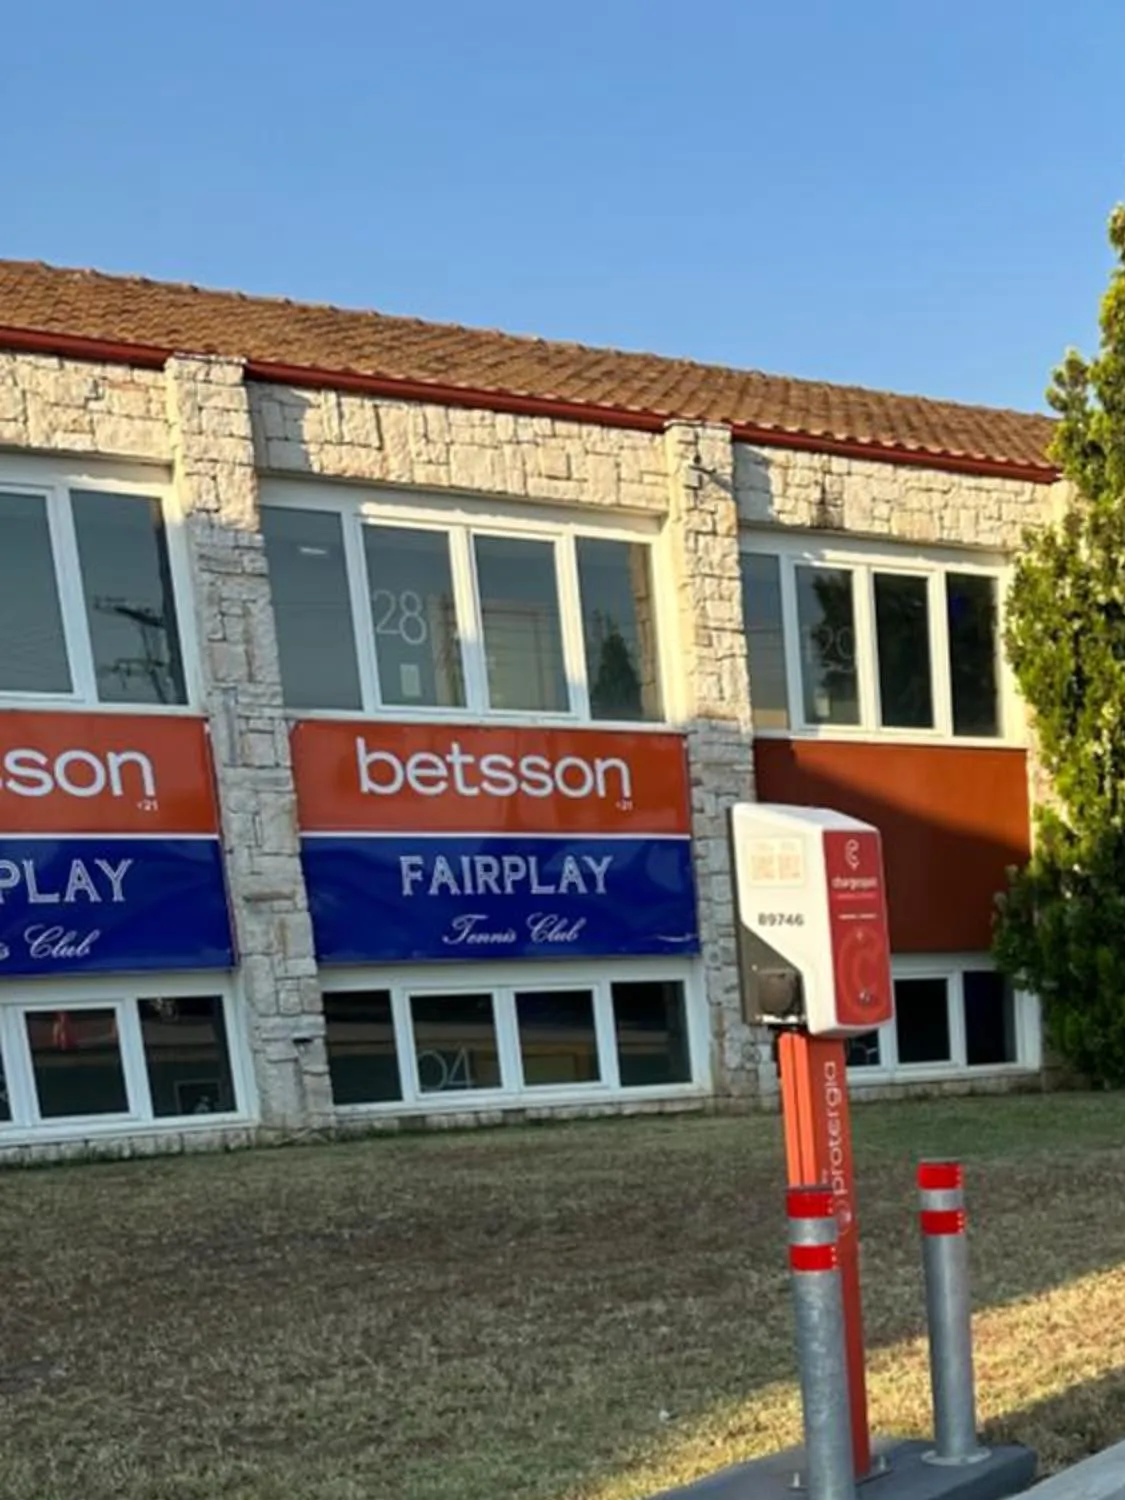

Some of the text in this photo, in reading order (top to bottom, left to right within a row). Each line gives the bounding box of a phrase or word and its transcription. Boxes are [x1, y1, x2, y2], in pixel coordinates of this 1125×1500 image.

[373, 589, 427, 645] 28
[0, 748, 156, 797] son
[355, 736, 631, 798] betsson
[0, 859, 133, 904] PLAY
[400, 855, 613, 896] FAIRPLAY
[24, 925, 100, 958] Club
[442, 912, 587, 945] Tennis Club
[824, 1061, 848, 1196] protergia
